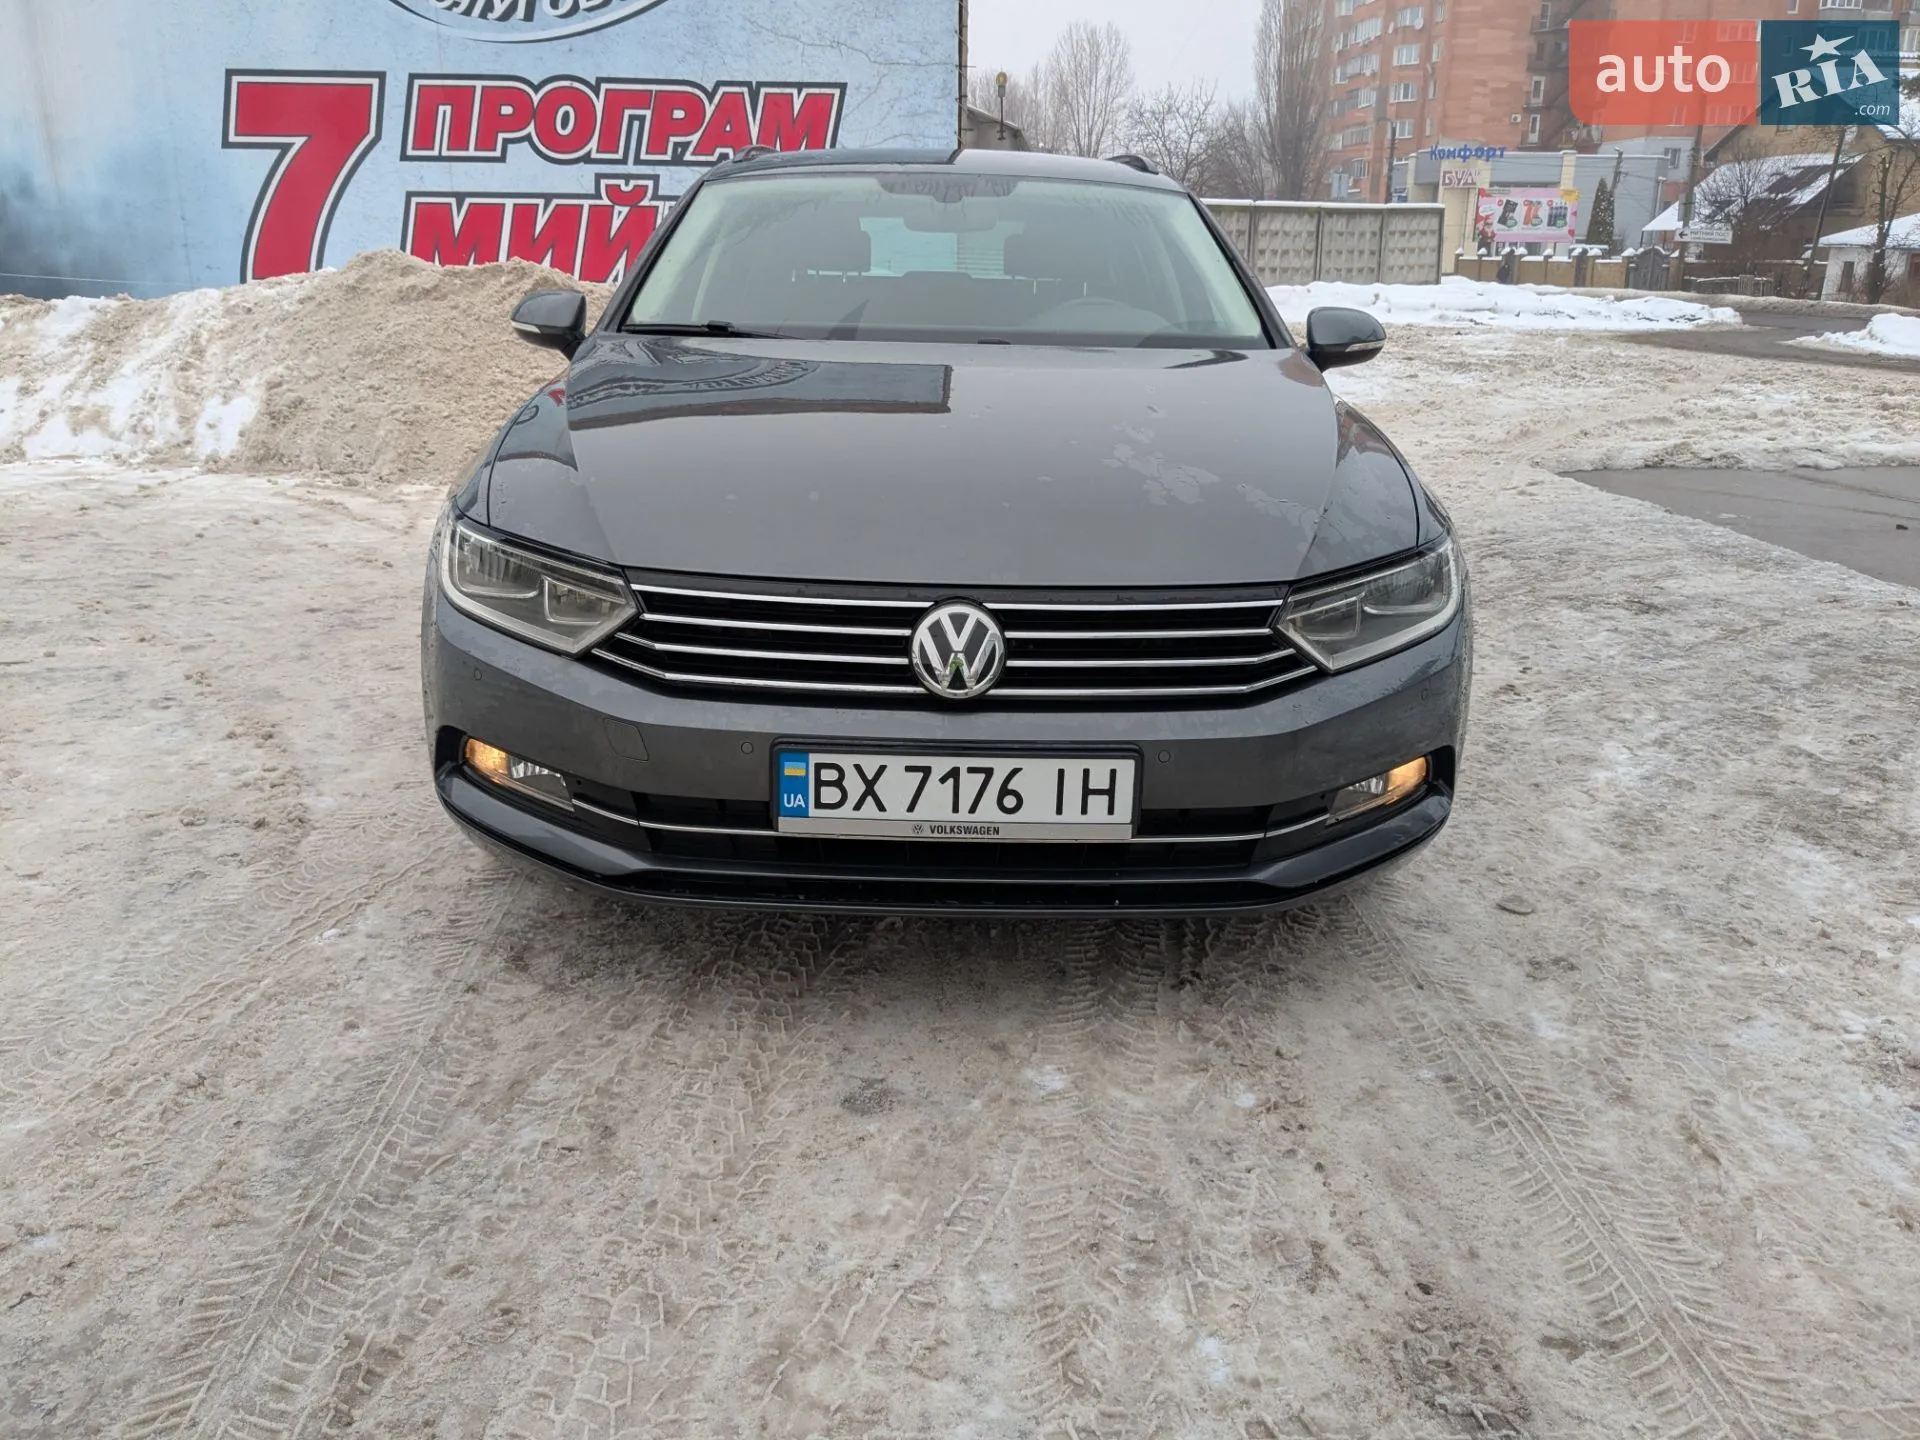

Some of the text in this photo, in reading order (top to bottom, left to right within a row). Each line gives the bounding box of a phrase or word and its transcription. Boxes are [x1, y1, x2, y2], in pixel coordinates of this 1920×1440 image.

[1430, 144, 1505, 163] Комфорт
[222, 69, 847, 284] 7 ПРОГРАМ
[402, 173, 682, 284] МИЙ
[784, 793, 806, 808] UA
[813, 762, 1117, 816] BX 7176 IH
[929, 825, 1000, 837] VOLKSWAGEN
